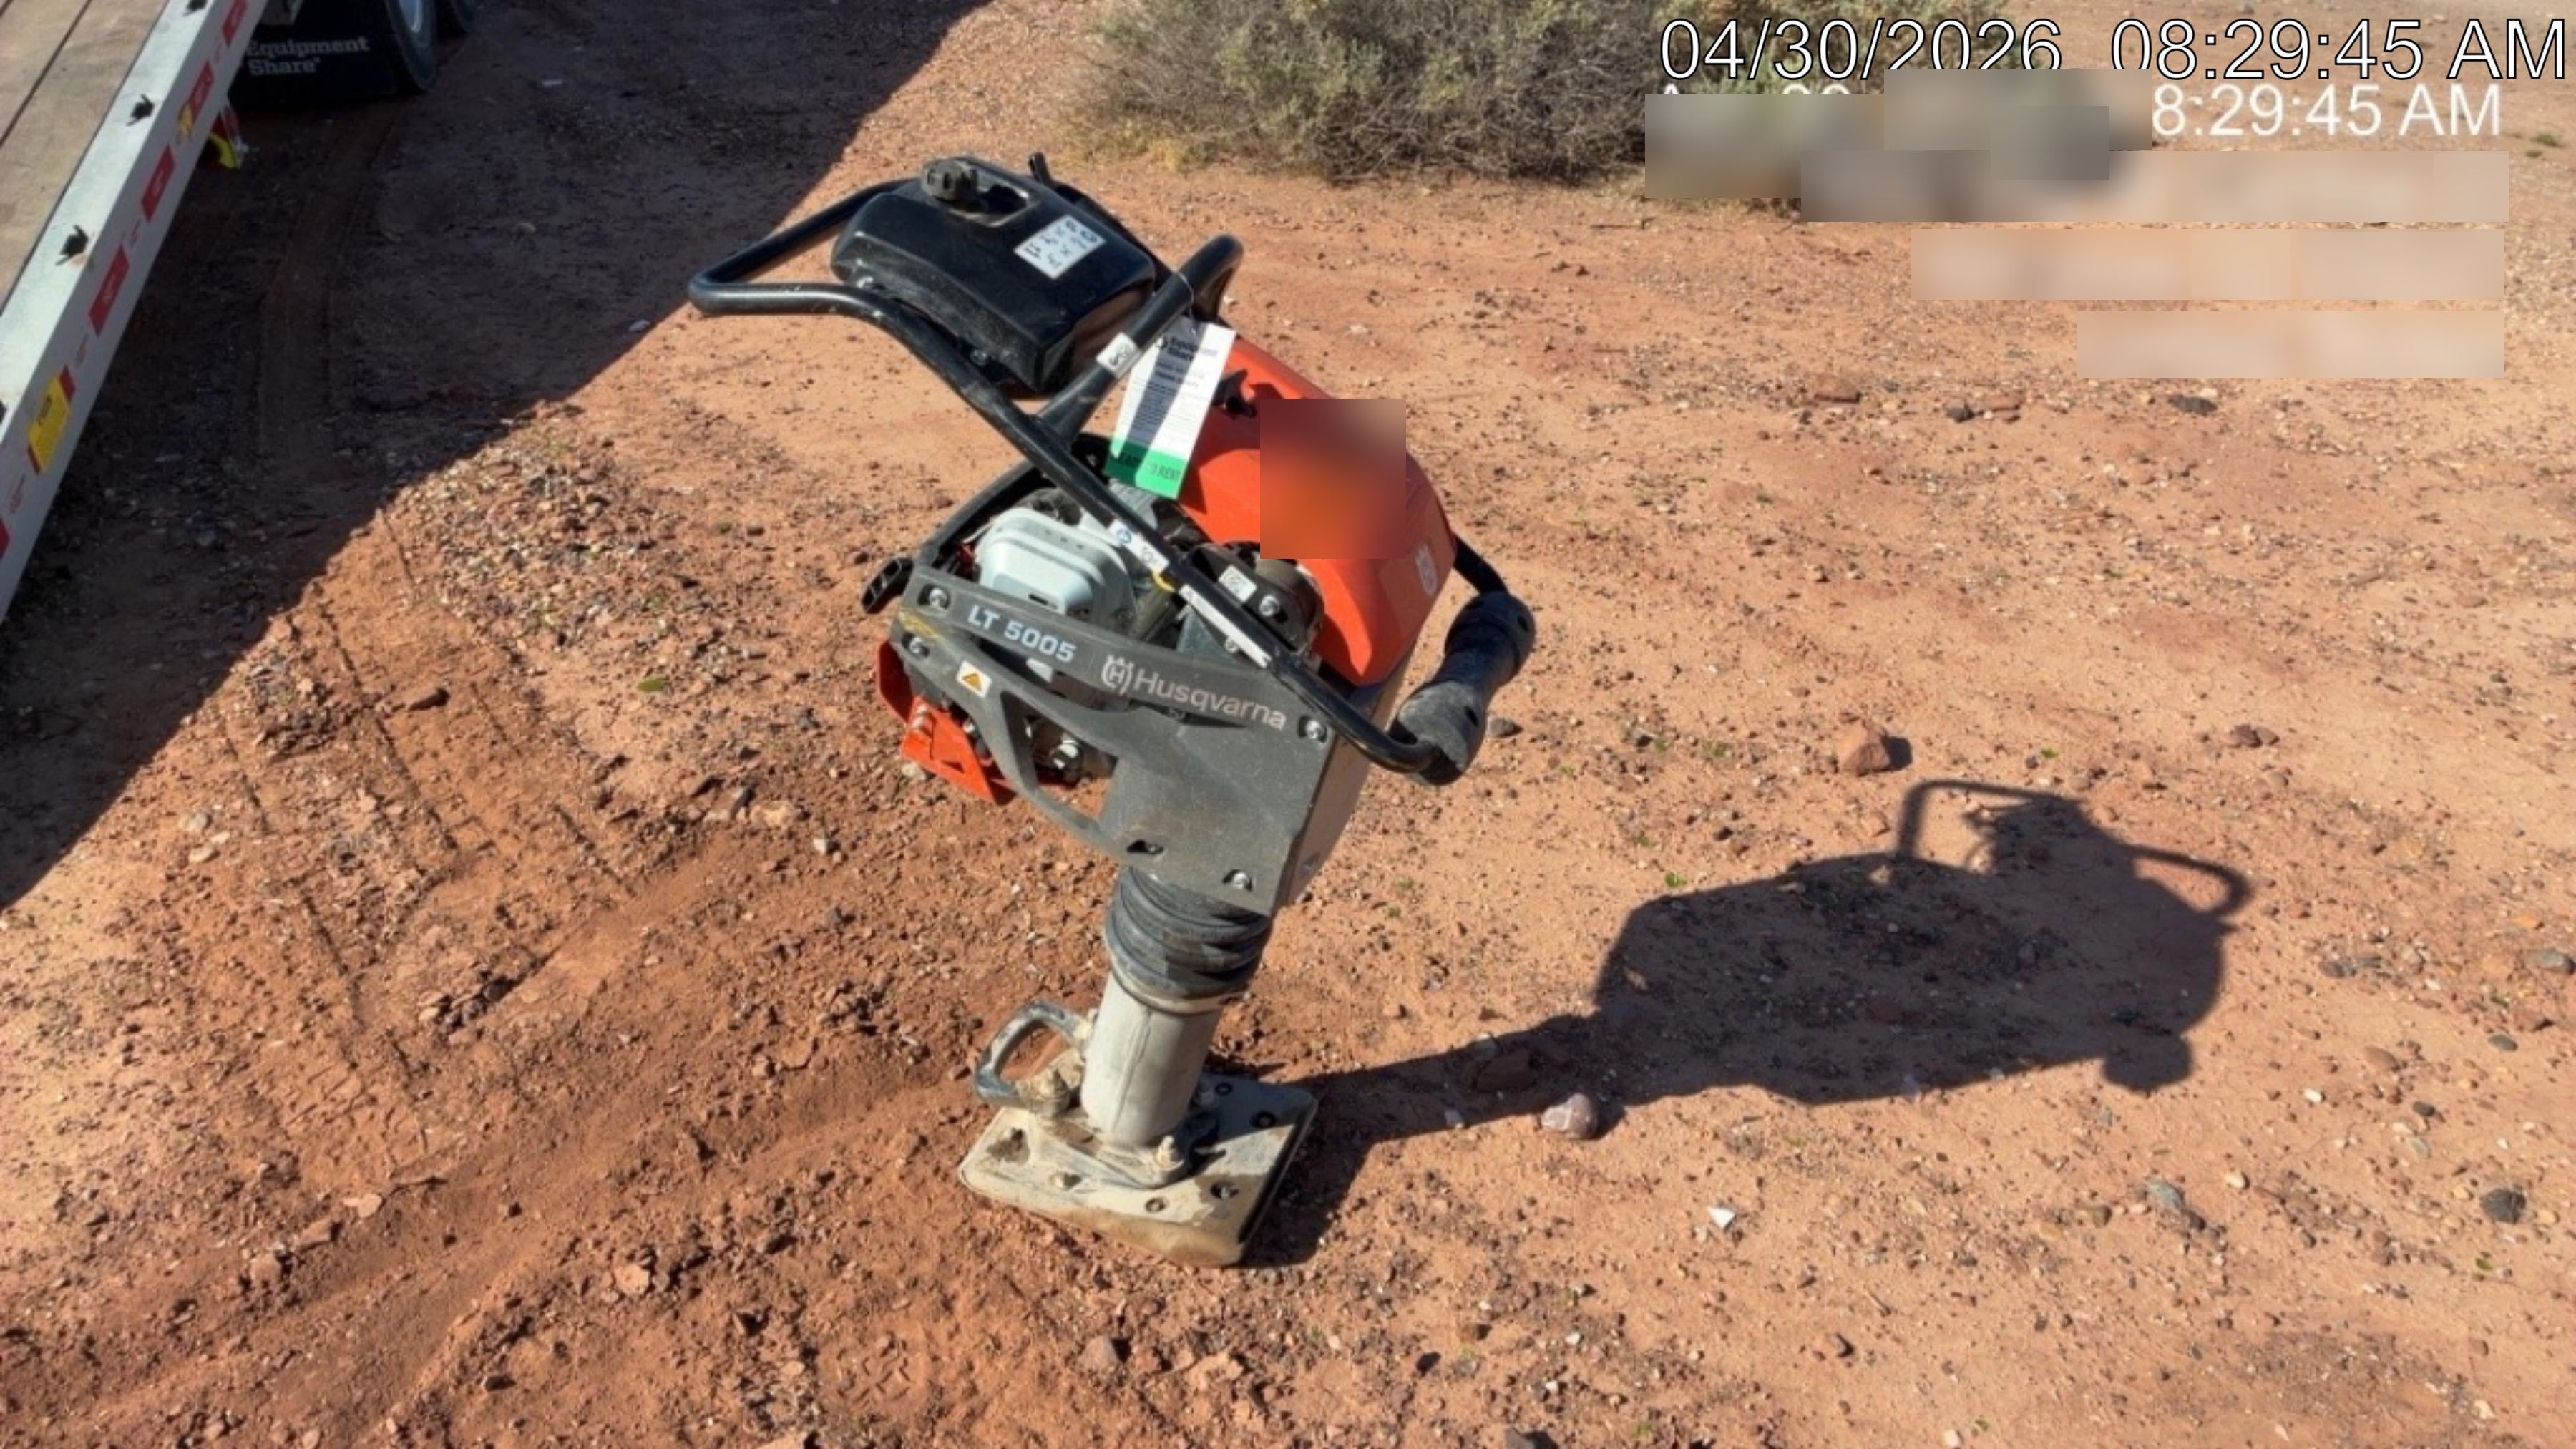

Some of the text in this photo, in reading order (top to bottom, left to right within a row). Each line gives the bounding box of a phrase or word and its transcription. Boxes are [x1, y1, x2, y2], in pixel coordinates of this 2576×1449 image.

[245, 36, 369, 59] Equipment
[248, 58, 318, 75] Share
[967, 605, 1077, 664] LT 5005
[1133, 668, 1287, 731] Husqvarna
